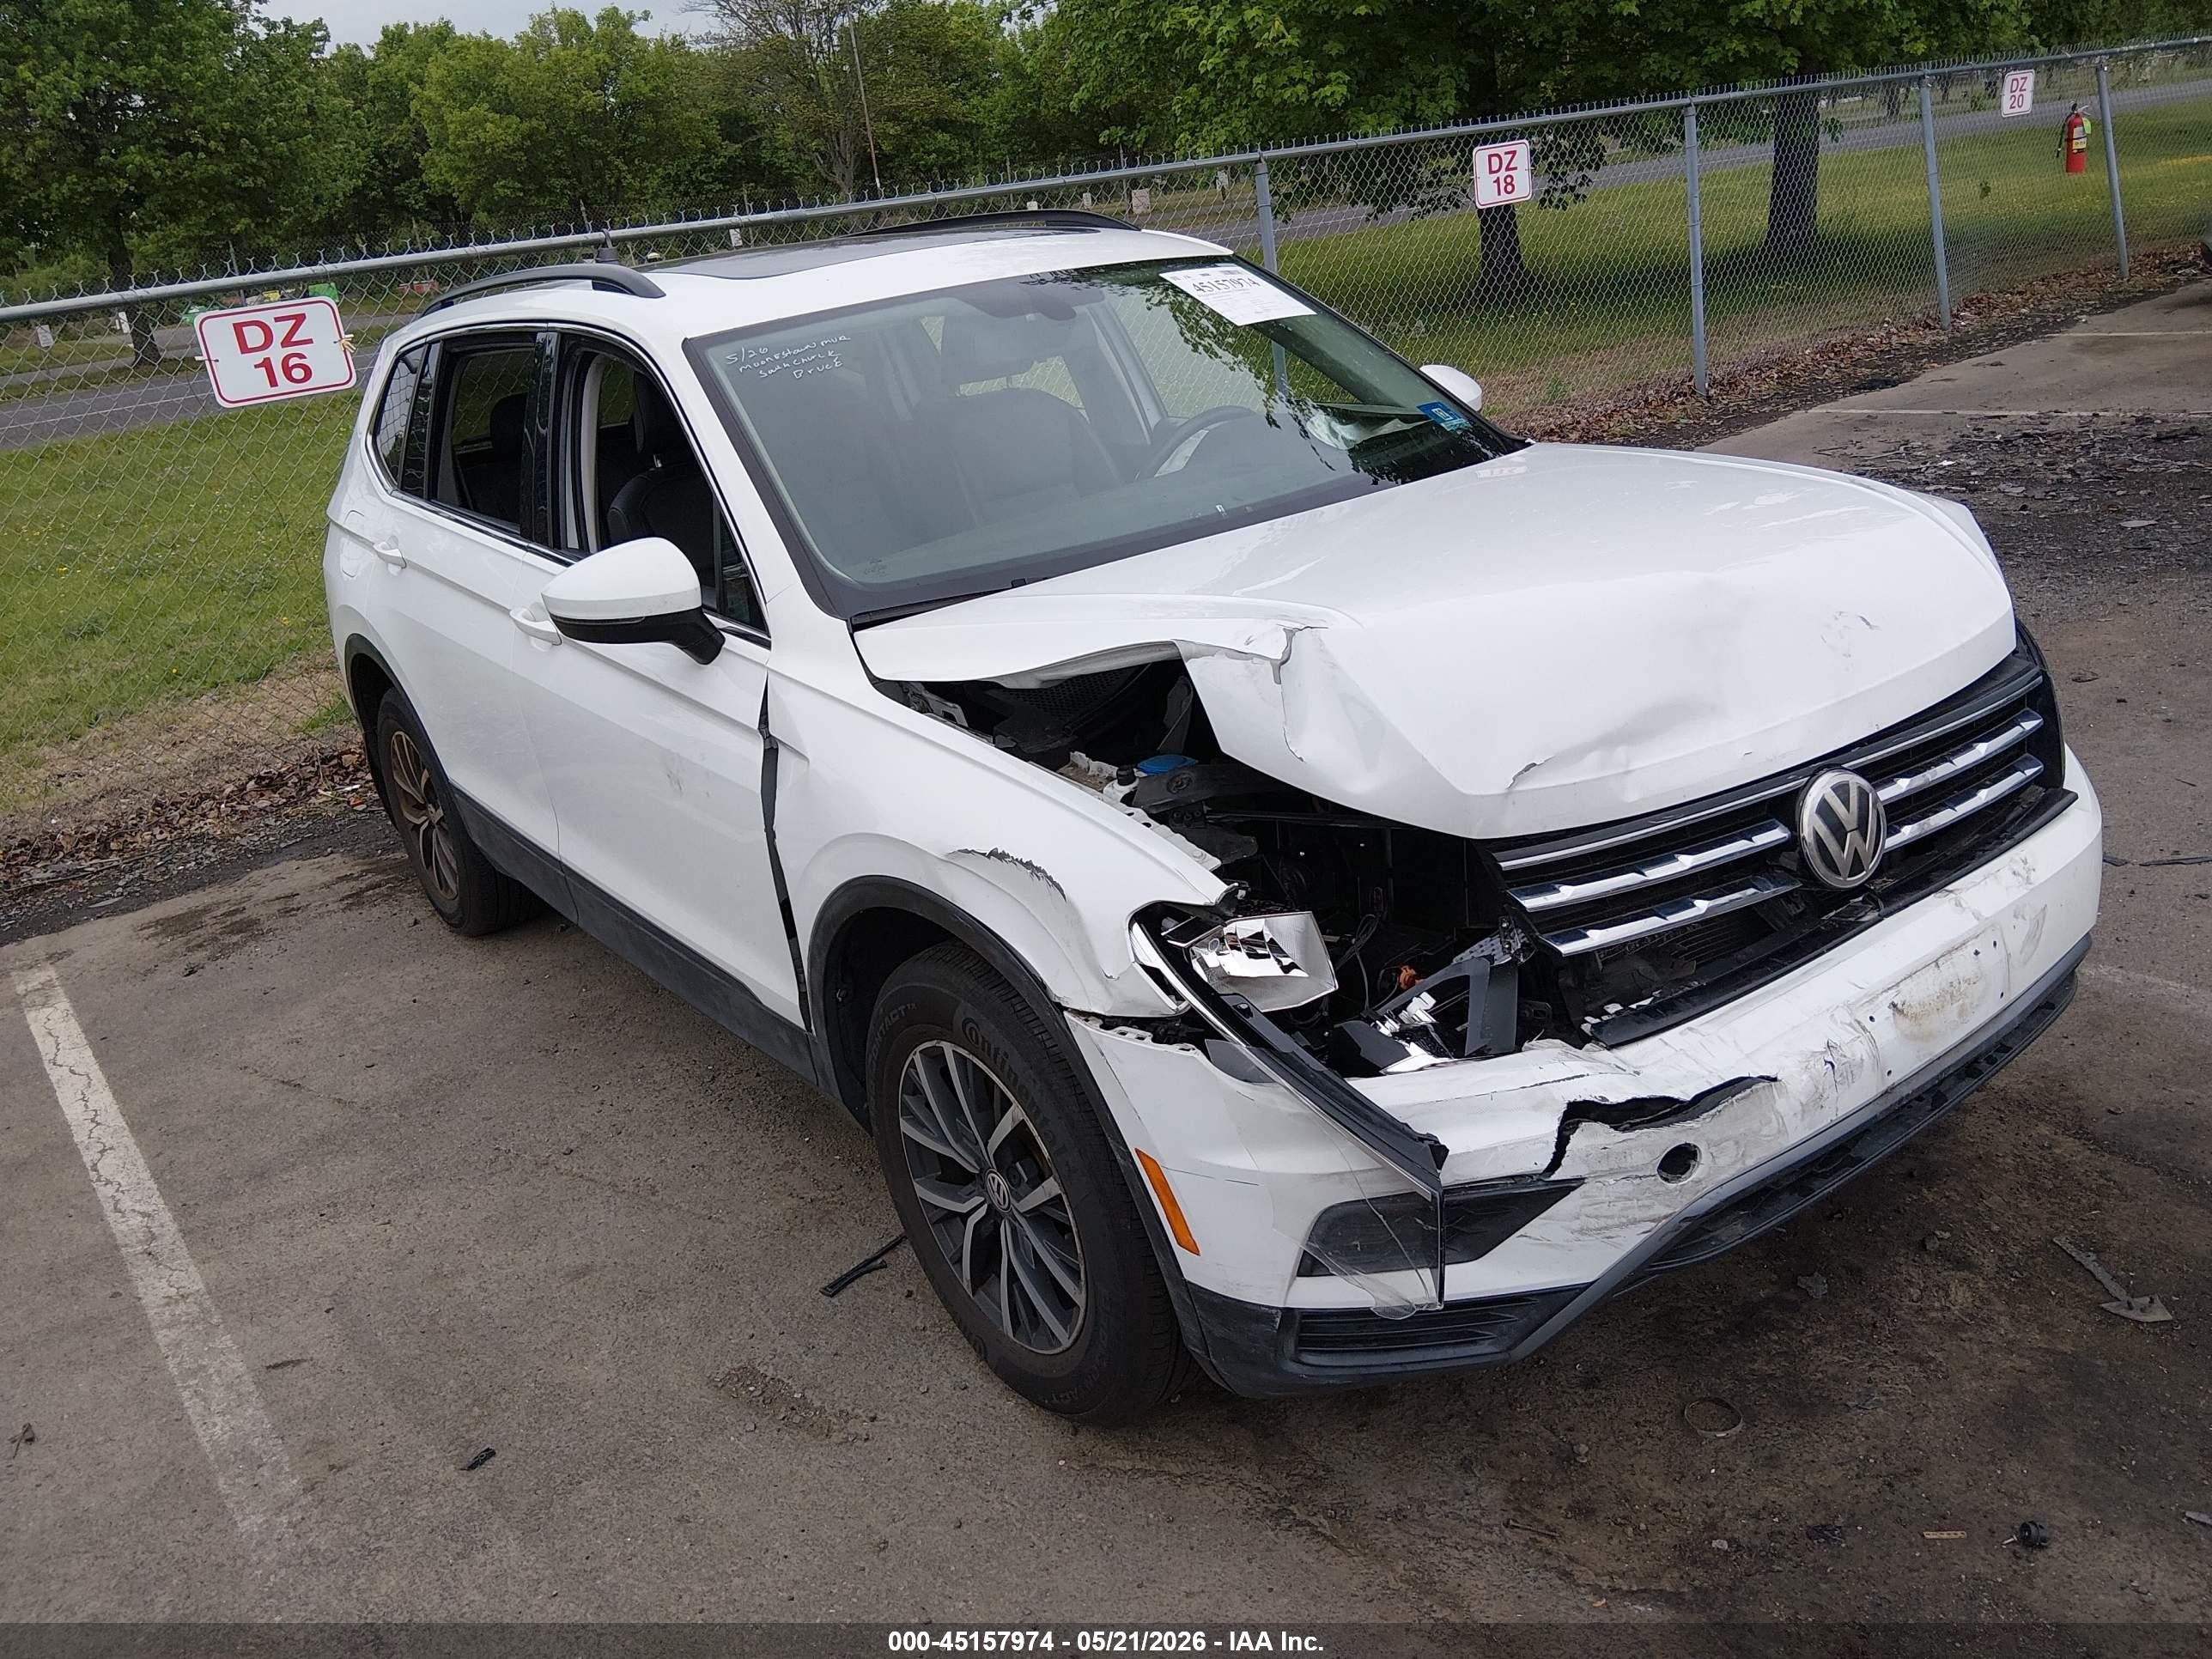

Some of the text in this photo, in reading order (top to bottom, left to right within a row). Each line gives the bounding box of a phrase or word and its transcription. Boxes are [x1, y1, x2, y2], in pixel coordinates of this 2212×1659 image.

[2009, 76, 2028, 94] DZ
[2008, 94, 2025, 109] 20
[1487, 149, 1518, 175] DZ
[1492, 173, 1516, 197] 18
[1192, 277, 1261, 293] 45157974
[232, 313, 314, 355] DZ
[726, 347, 769, 365] 5/26
[253, 352, 313, 388] 16
